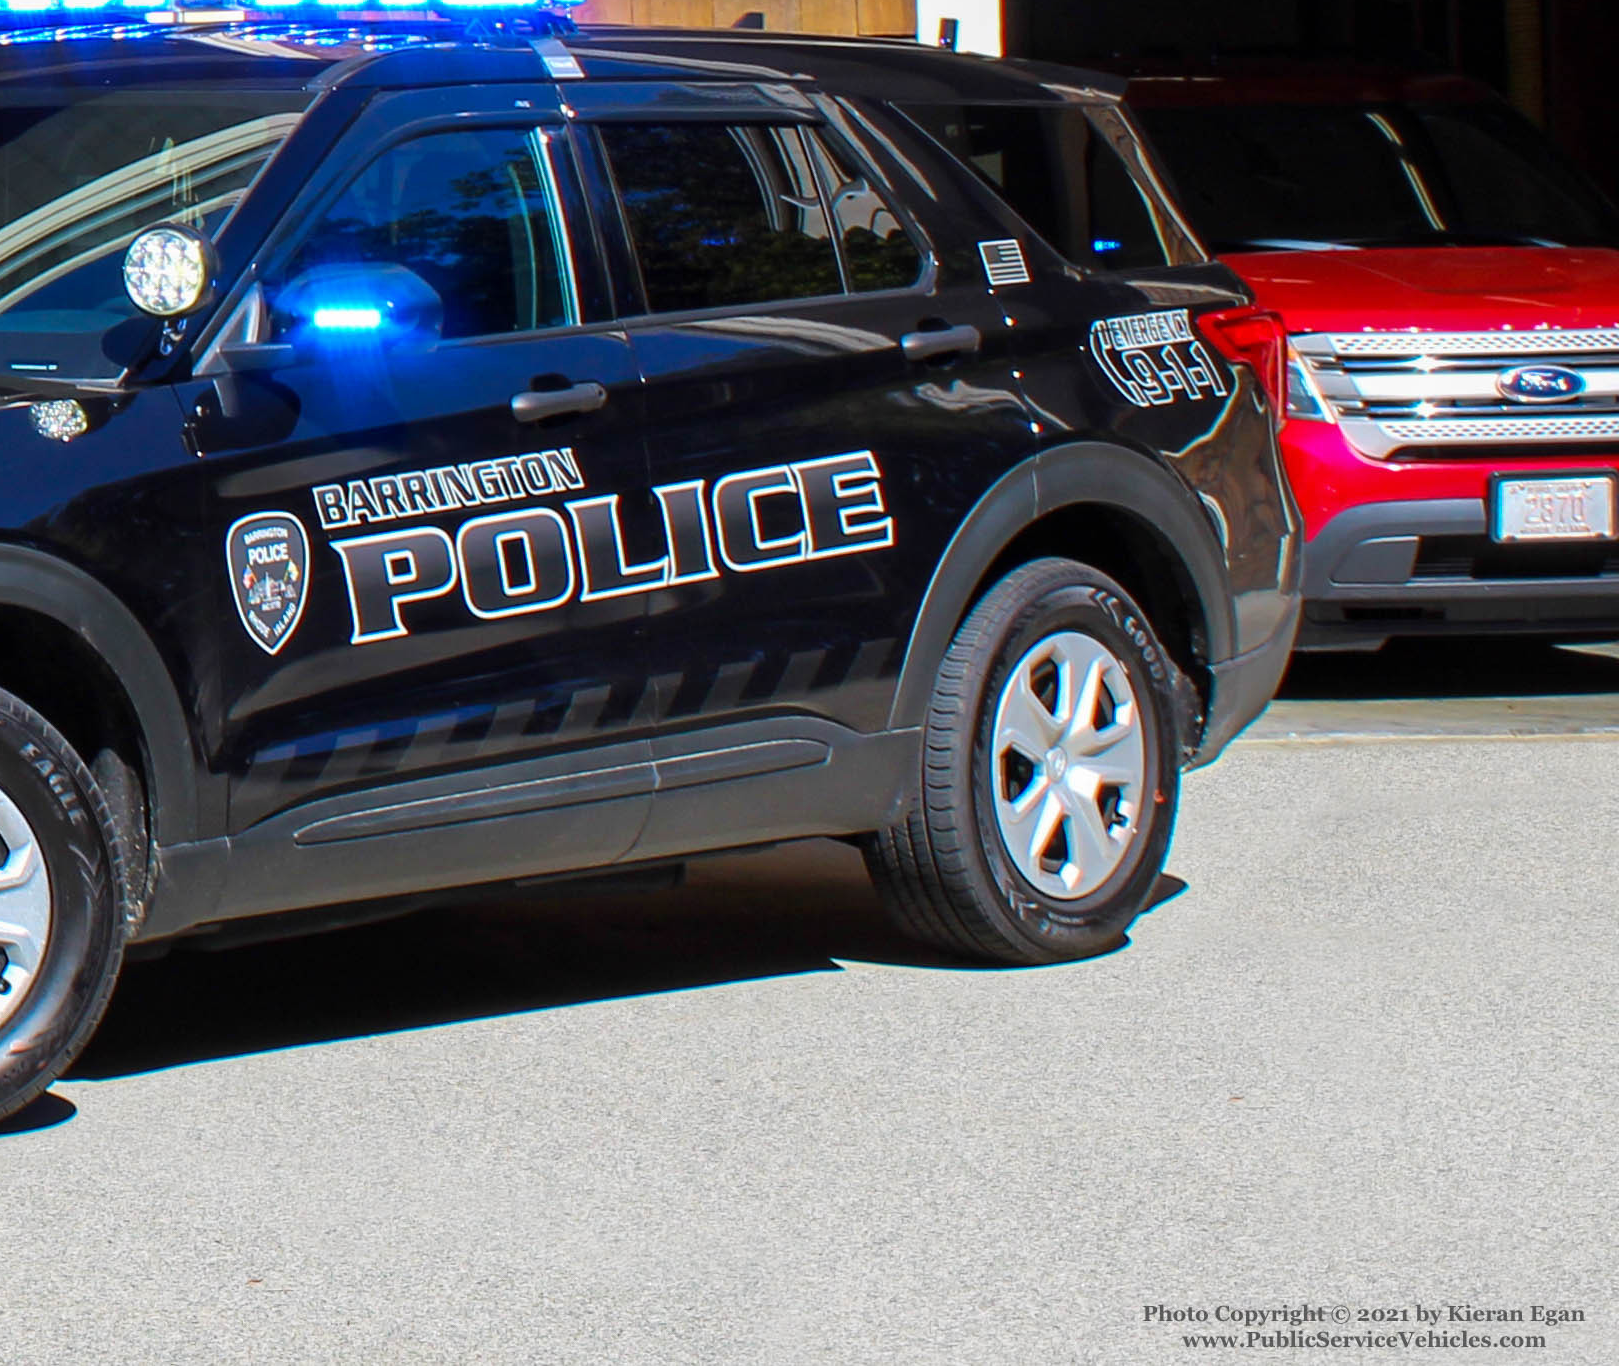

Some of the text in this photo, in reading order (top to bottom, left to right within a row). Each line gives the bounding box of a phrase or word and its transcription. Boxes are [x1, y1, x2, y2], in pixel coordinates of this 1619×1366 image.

[1121, 340, 1227, 405] 9-1-1
[312, 447, 585, 529] BARRINGTON
[248, 542, 289, 565] POLICE
[330, 450, 894, 644] POLICE
